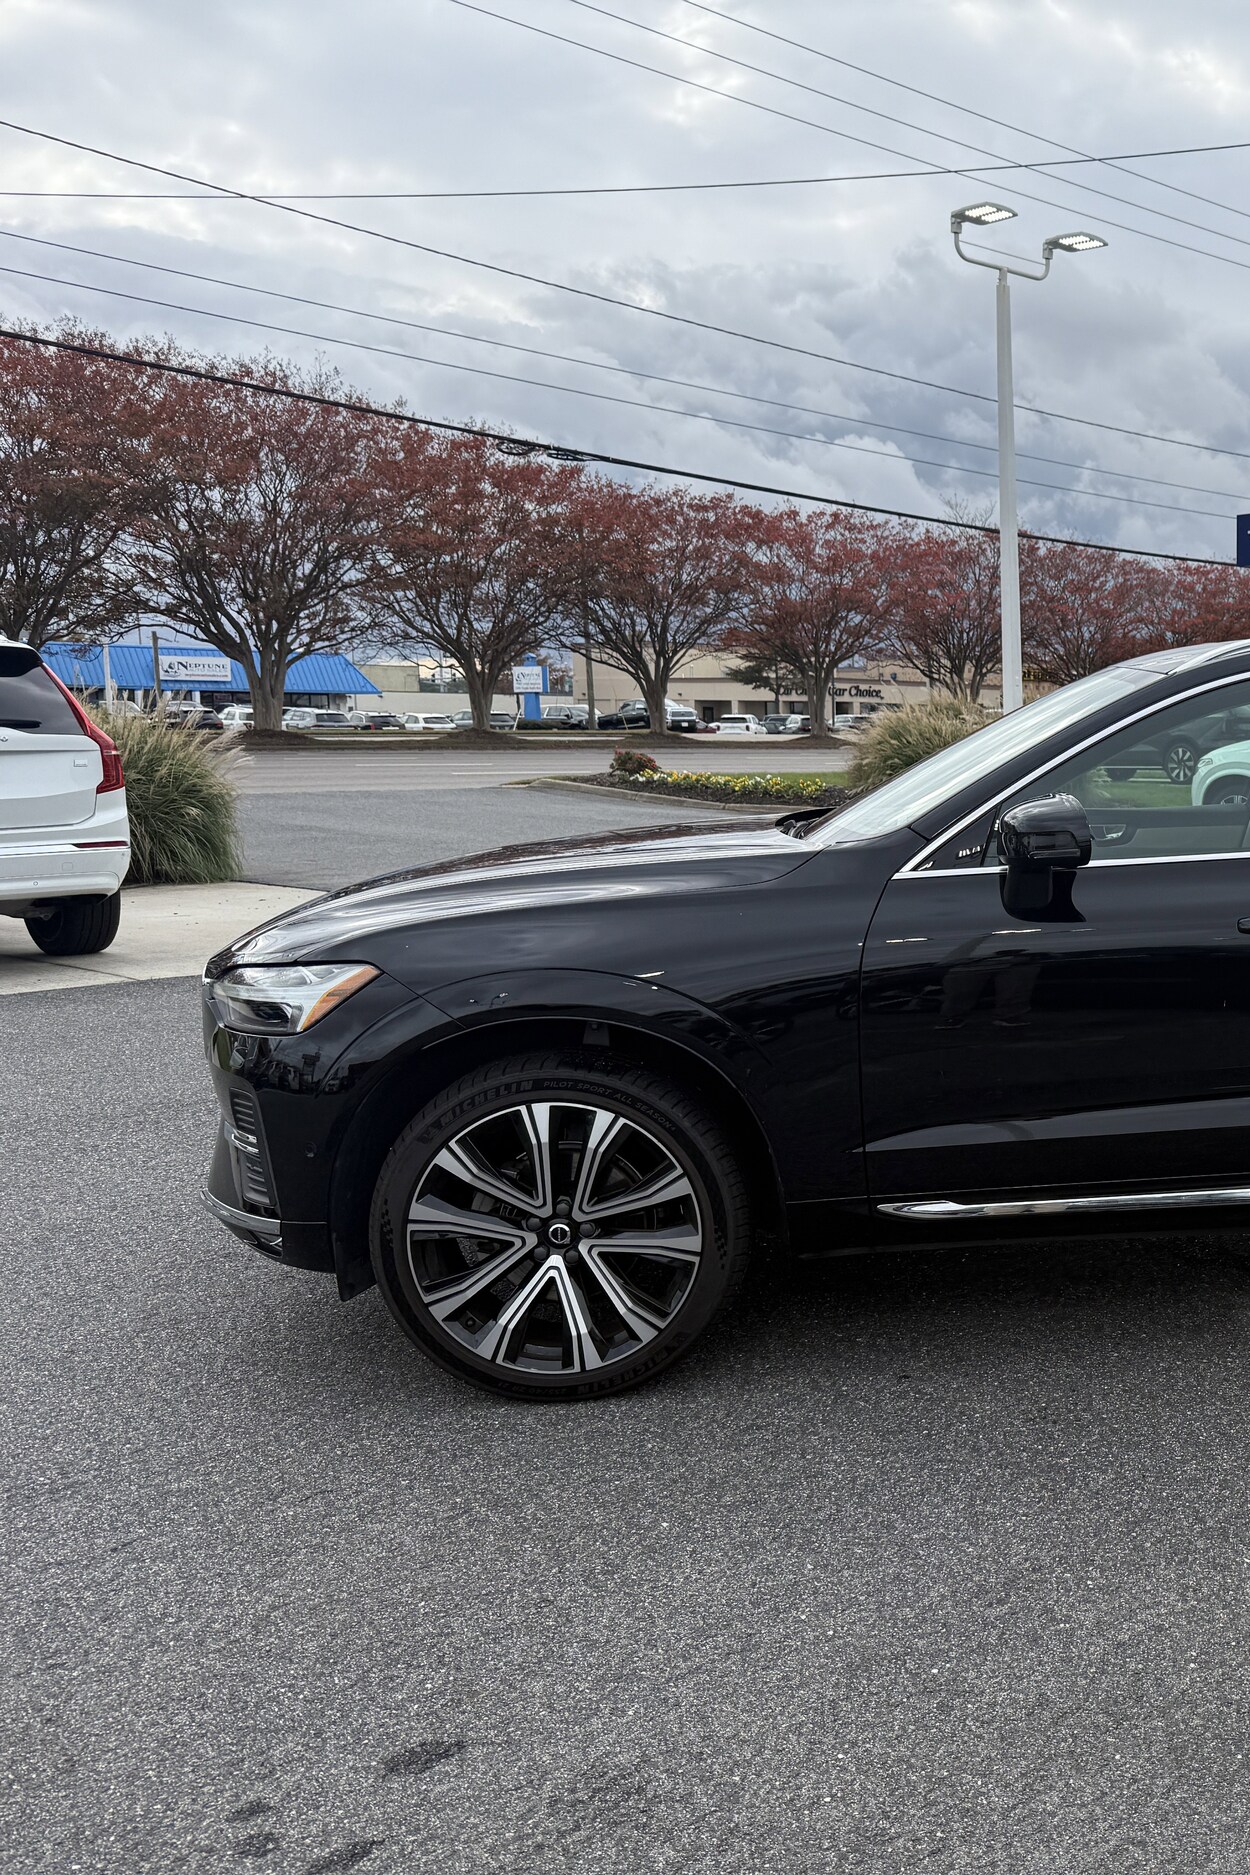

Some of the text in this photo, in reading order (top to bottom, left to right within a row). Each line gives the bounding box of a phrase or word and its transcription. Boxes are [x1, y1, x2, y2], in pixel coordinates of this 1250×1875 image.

[828, 685, 847, 697] Car
[439, 1080, 534, 1127] MICHELIN
[543, 1080, 574, 1088] PILOT
[576, 1082, 613, 1095] SPORT
[613, 1093, 632, 1104] ALL
